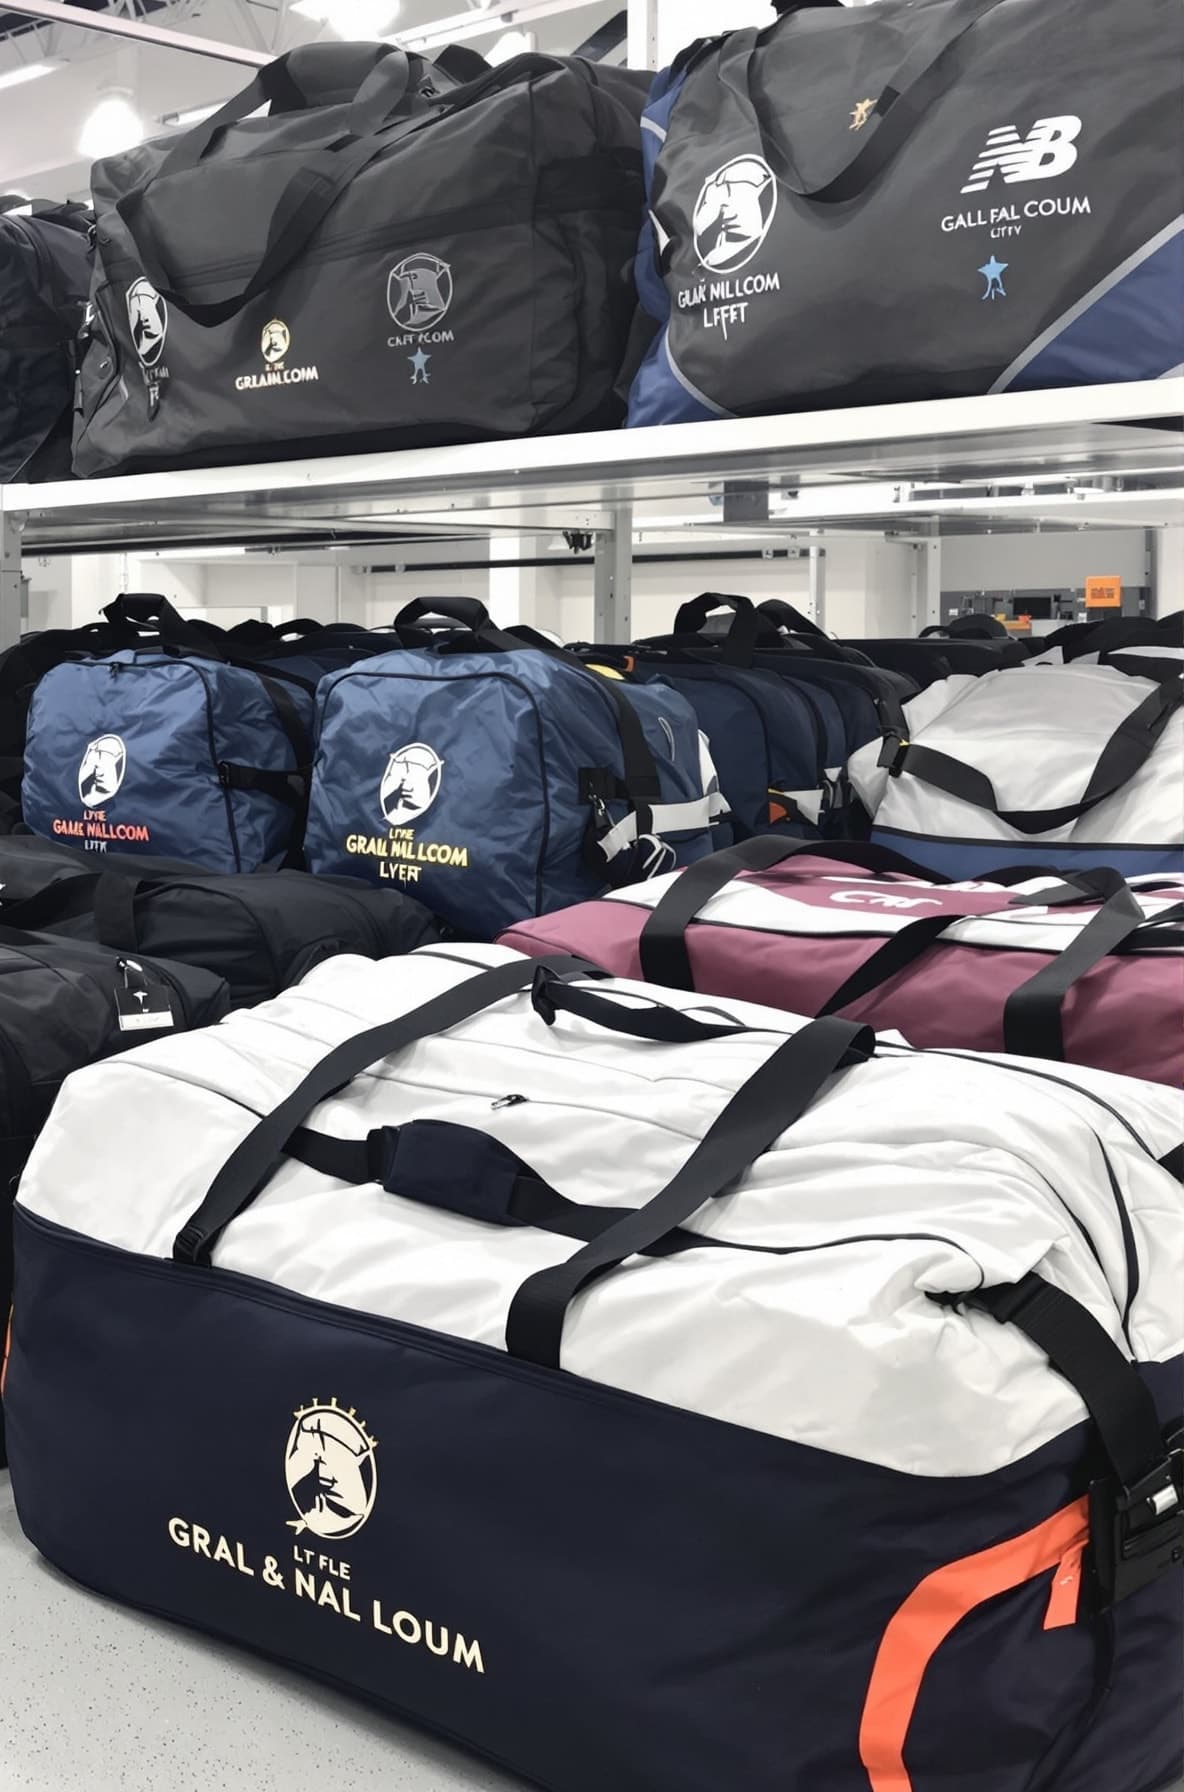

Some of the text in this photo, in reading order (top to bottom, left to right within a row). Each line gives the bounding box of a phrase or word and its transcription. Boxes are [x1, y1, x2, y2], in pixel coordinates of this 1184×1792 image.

[960, 115, 1082, 194] NB
[941, 196, 1091, 232] GALL FAL COUM
[168, 1516, 486, 1674] GRAL & NAL LOUM
[319, 1555, 351, 1580] FLE
